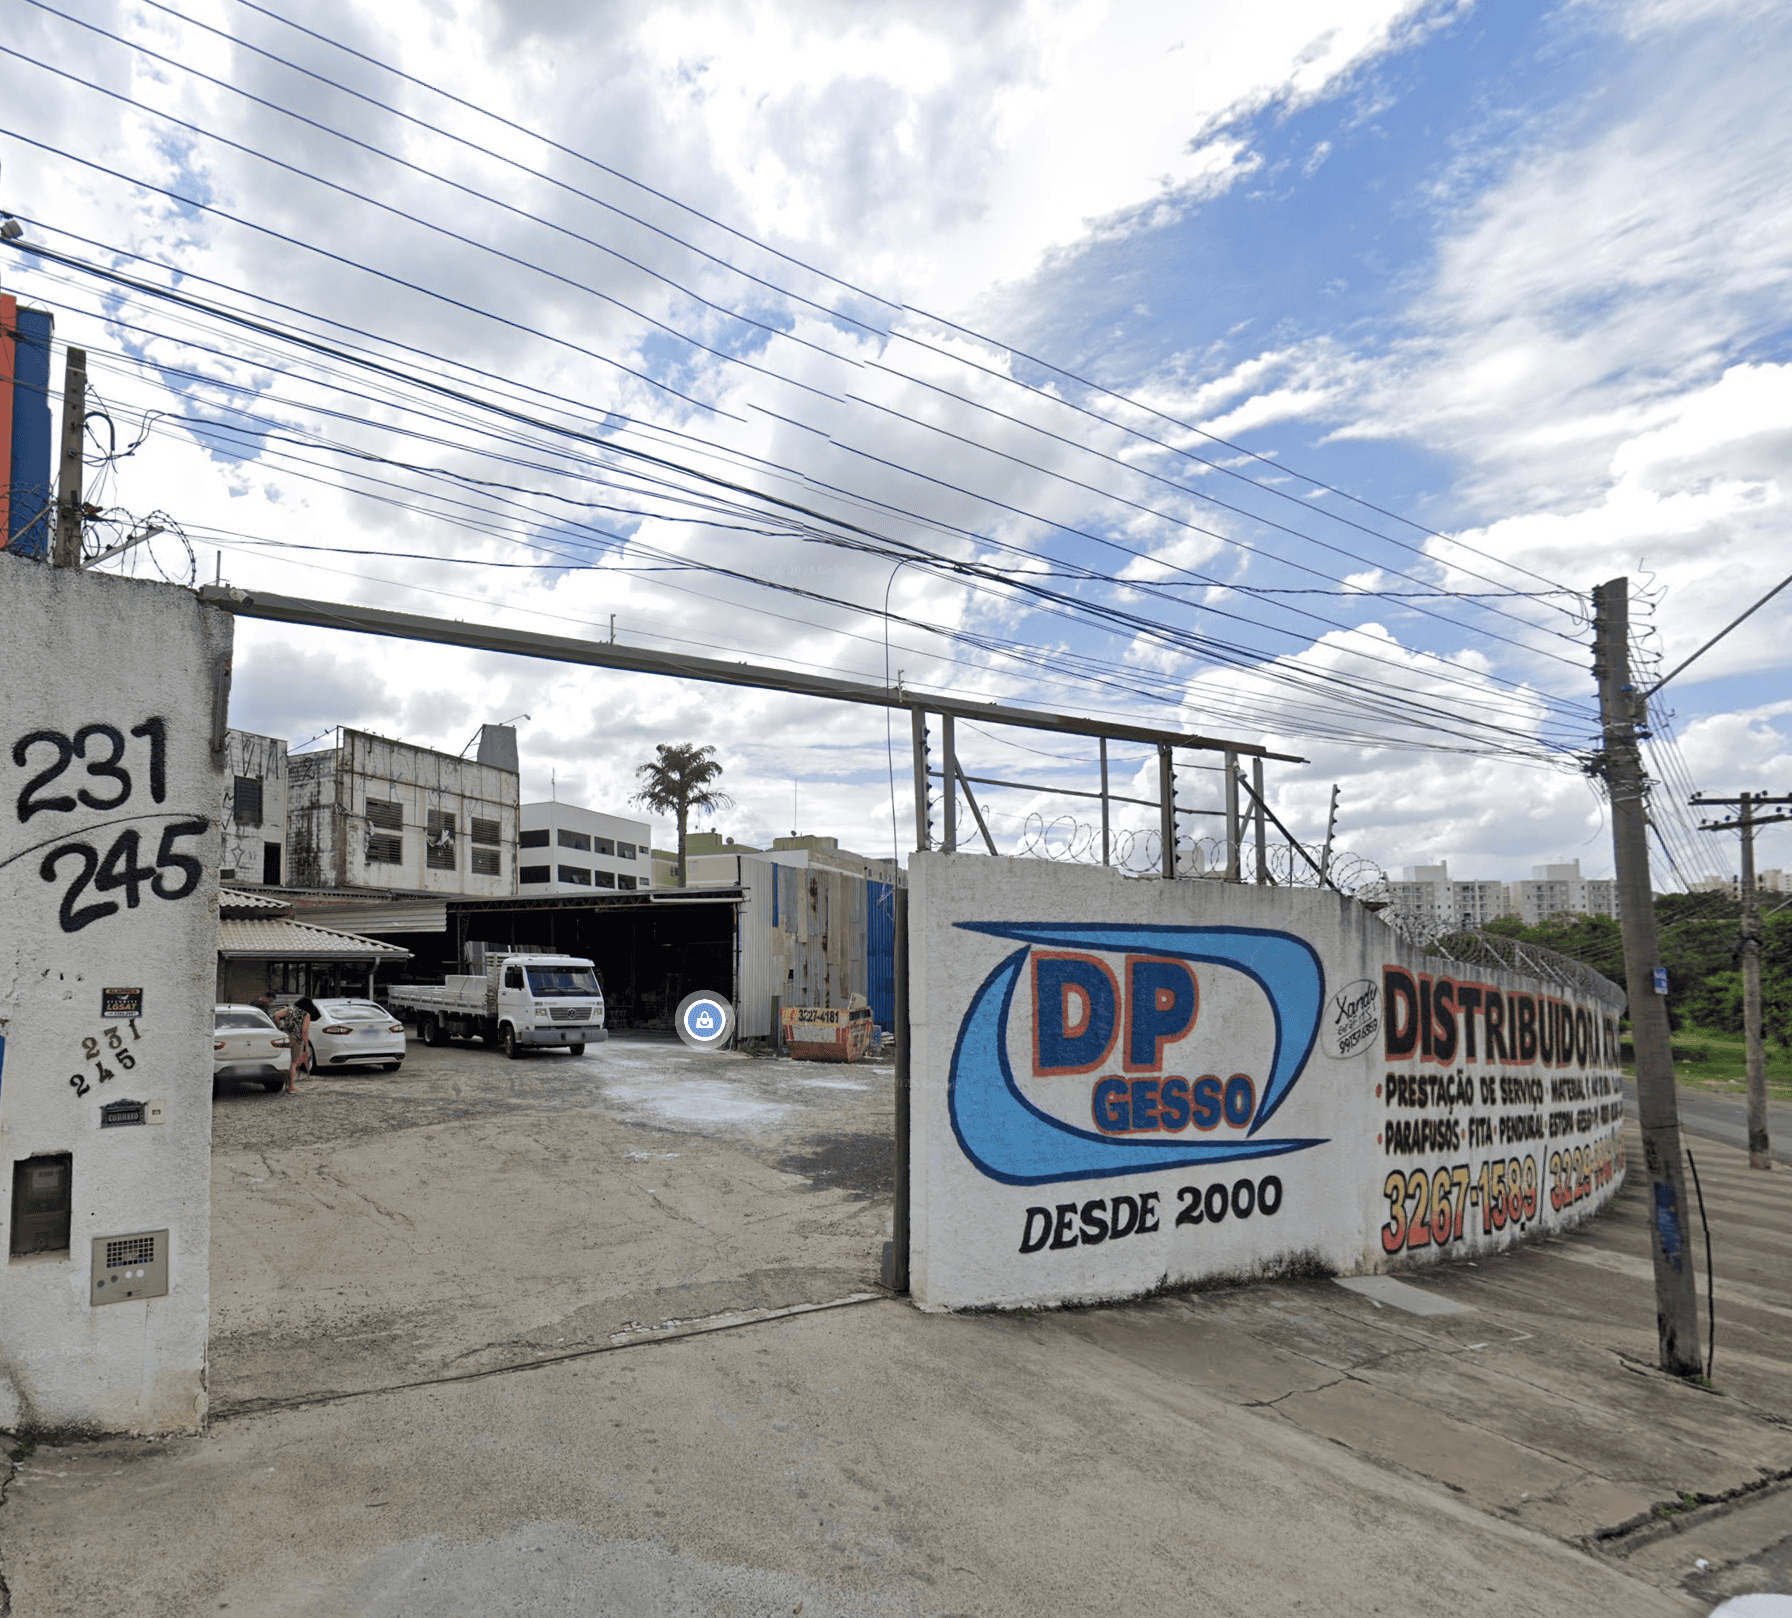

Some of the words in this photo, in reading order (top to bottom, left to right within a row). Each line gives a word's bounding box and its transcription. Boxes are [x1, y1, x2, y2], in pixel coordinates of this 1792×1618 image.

[12, 715, 167, 823] 231
[39, 819, 209, 933] 245
[81, 1018, 142, 1061] 231
[798, 1008, 839, 1023] 3227-4181
[1030, 951, 1200, 1077] DP
[69, 1047, 136, 1098] 245
[1385, 1068, 1475, 1115] PRESTAÇÃO
[1480, 1076, 1497, 1105] DE
[1500, 1076, 1544, 1112] SERVIÇO
[108, 1111, 139, 1123] CORREIO
[1091, 1073, 1256, 1136] GESSO
[1385, 1118, 1461, 1155] PARAFUSOS
[1468, 1116, 1494, 1148] FITA
[1018, 1191, 1160, 1254] DESDE
[1176, 1175, 1282, 1229] 2000
[1381, 1153, 1538, 1255] 3267-1589
